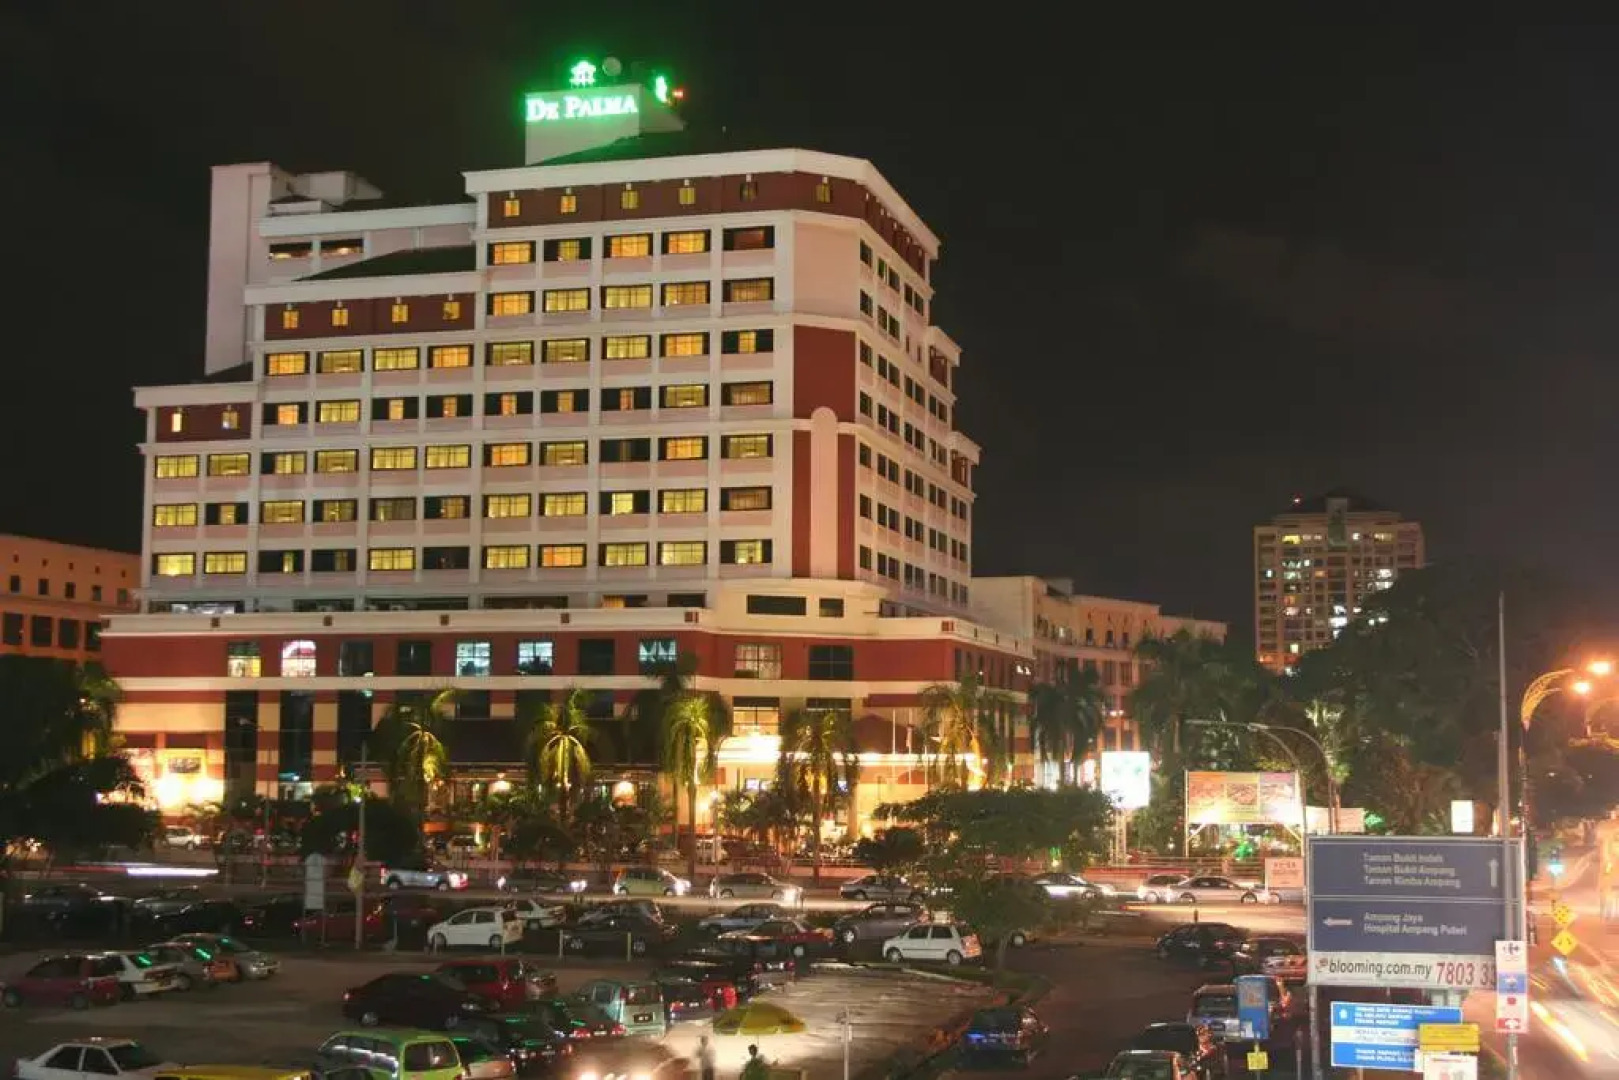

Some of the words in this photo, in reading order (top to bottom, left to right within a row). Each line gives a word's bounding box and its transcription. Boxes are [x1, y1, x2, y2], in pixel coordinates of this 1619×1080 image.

[1364, 923, 1400, 935] Hospital
[1402, 924, 1438, 936] Ampang
[1329, 960, 1432, 979] blooming.com.my
[1436, 962, 1475, 985] 7803
